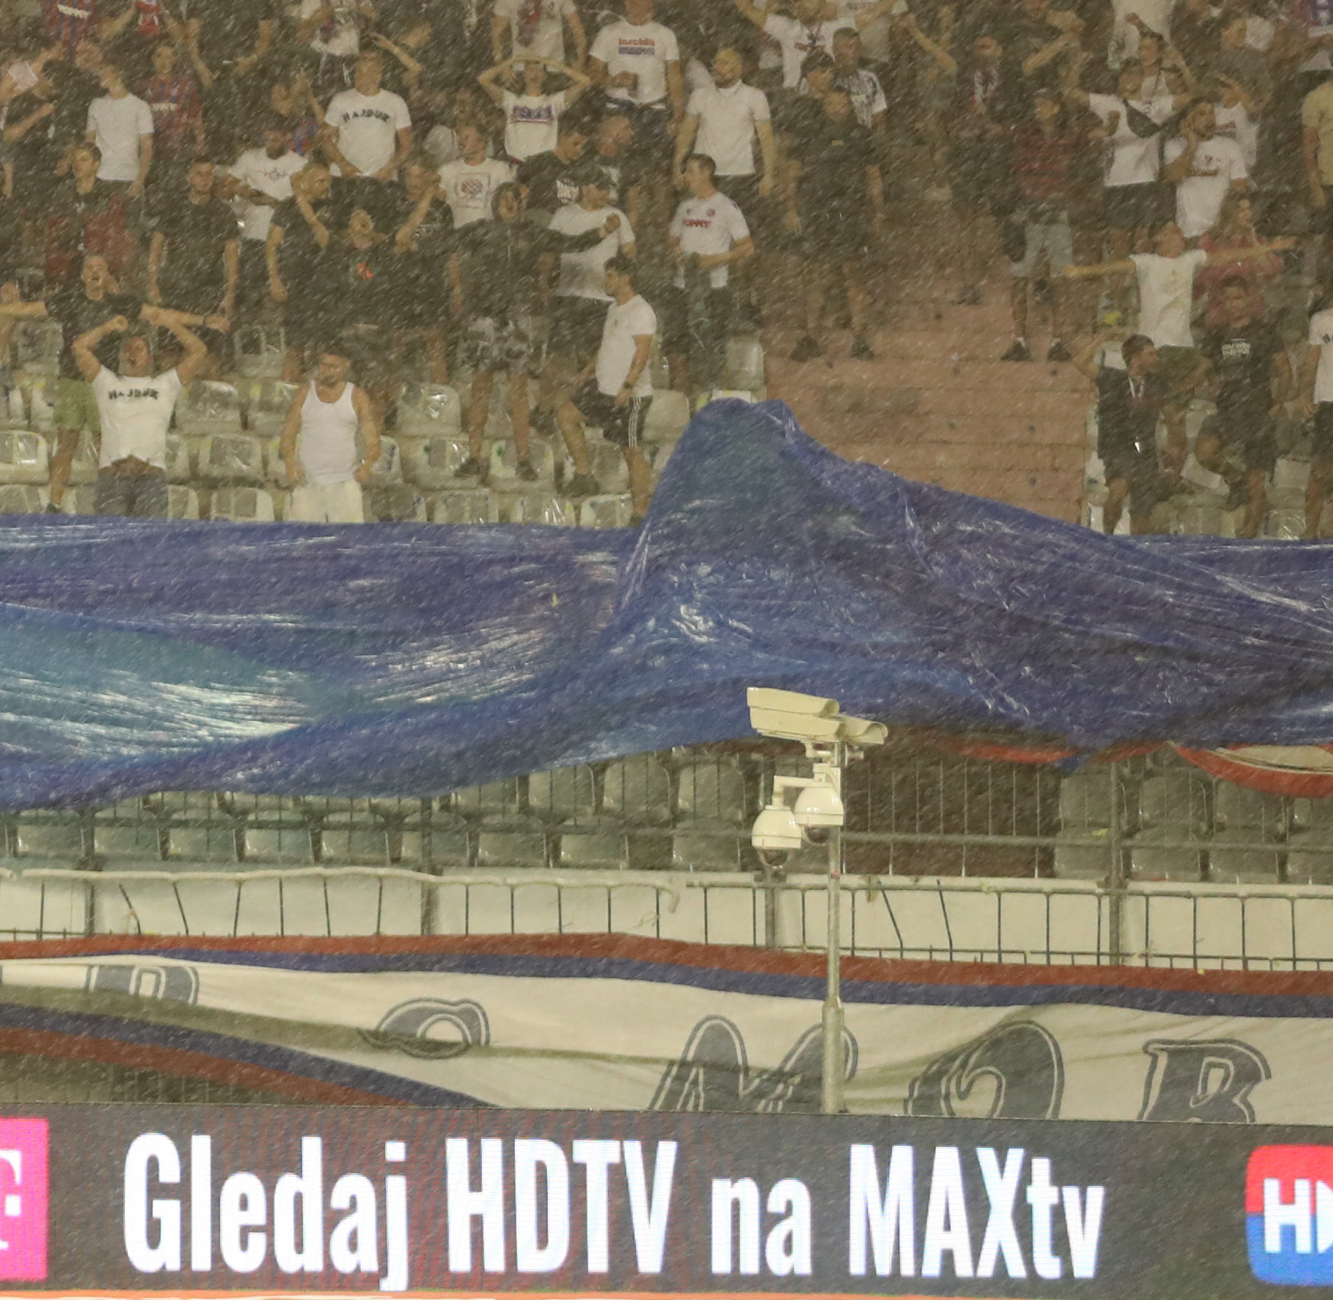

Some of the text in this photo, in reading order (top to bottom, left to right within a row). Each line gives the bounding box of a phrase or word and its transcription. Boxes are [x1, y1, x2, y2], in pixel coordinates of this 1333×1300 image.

[123, 1133, 1105, 1292] Gledaj HDTV na MAXtv
